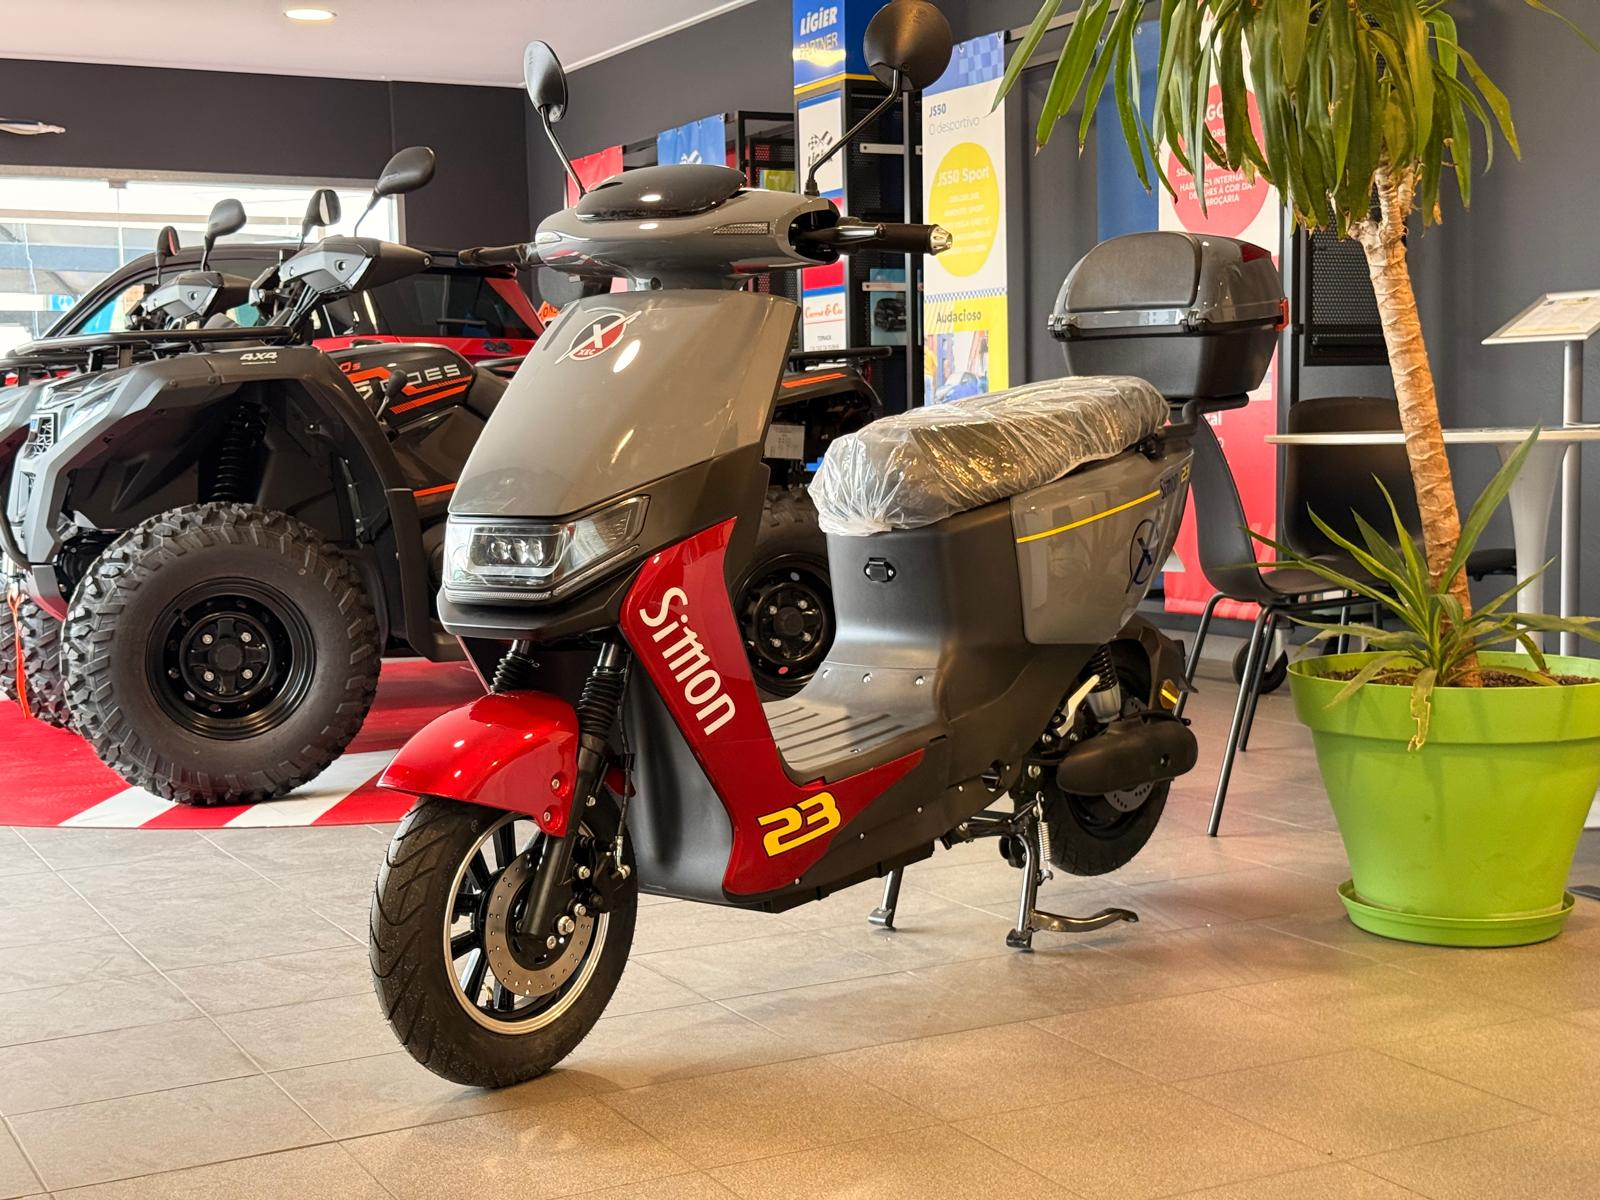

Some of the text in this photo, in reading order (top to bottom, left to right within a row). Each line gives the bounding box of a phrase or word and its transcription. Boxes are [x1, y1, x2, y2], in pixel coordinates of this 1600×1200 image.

[928, 103, 947, 118] JS50
[937, 166, 990, 188] JS50 Sport
[936, 309, 982, 324] Audacioso
[639, 586, 736, 736] Simon
[757, 791, 842, 858] 23
